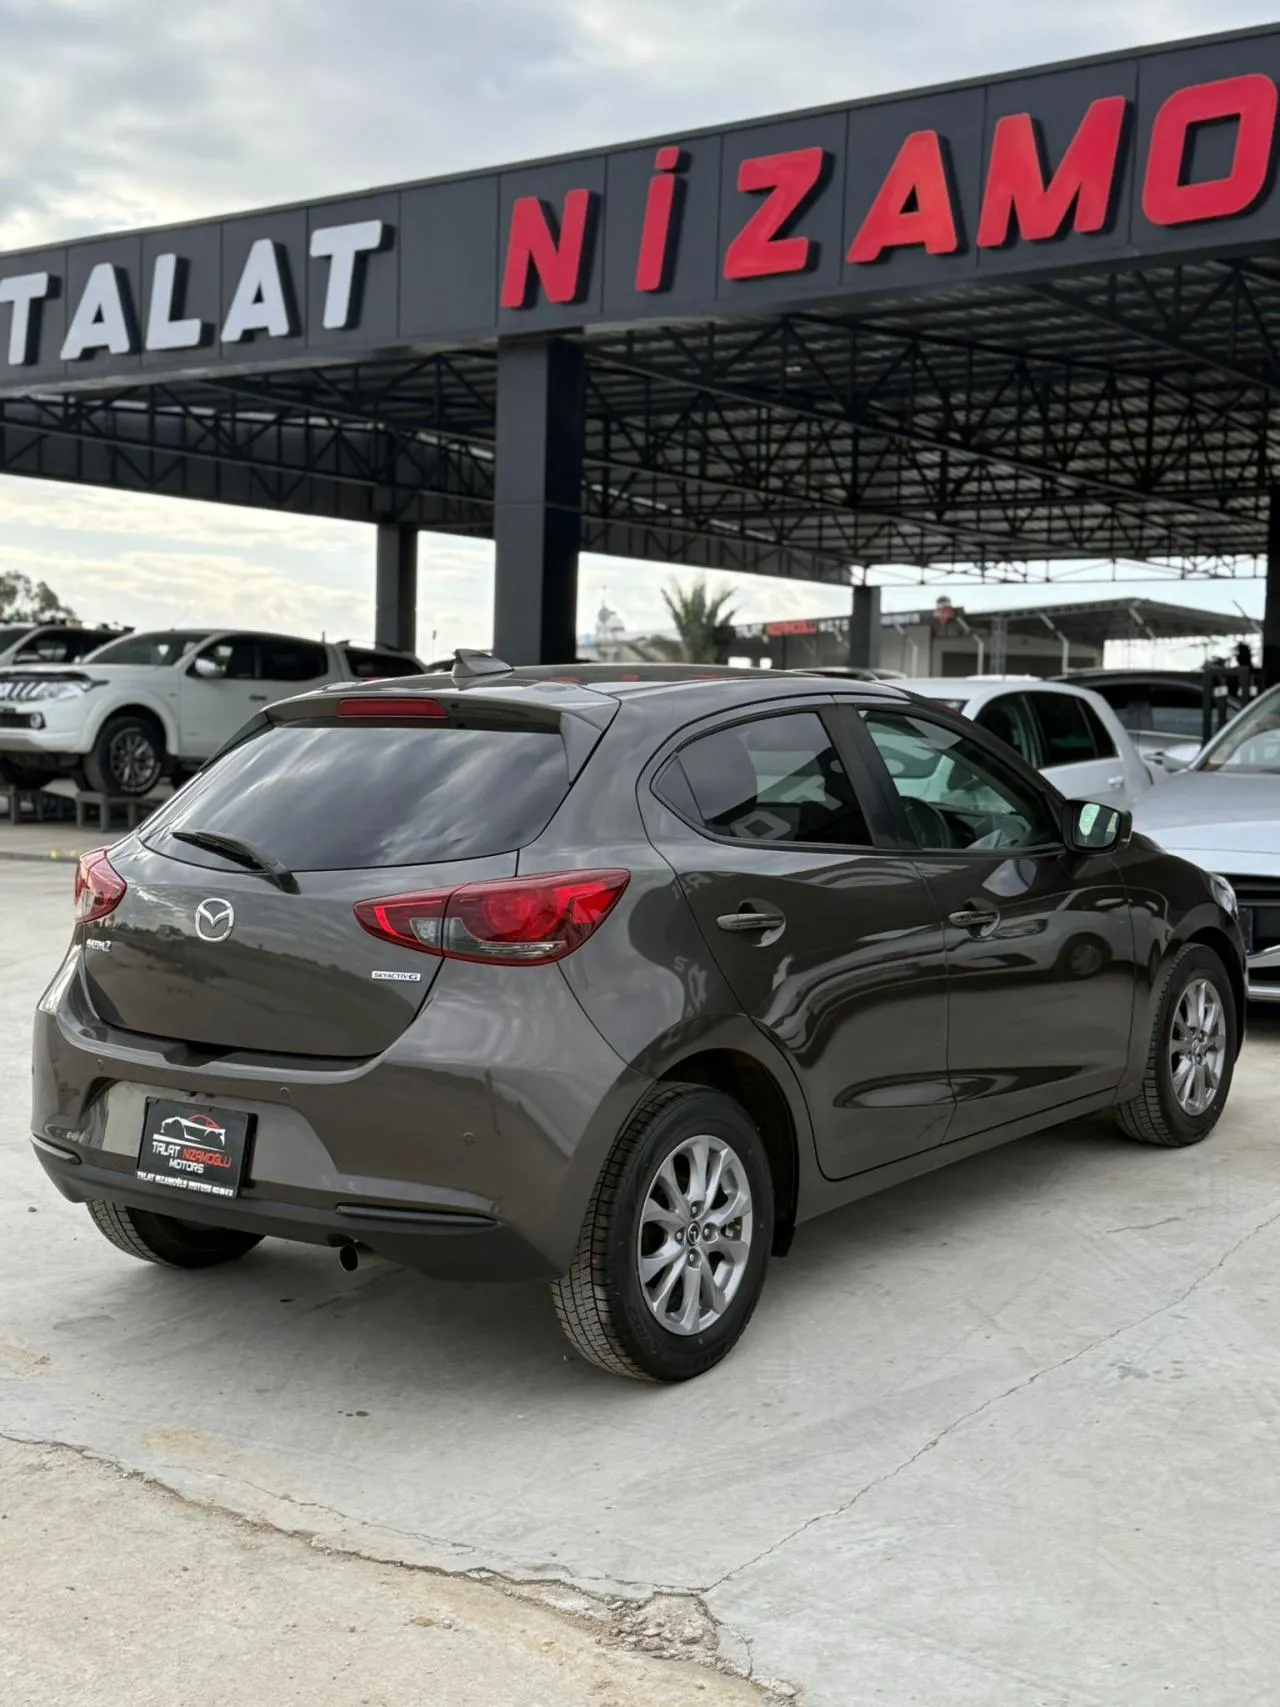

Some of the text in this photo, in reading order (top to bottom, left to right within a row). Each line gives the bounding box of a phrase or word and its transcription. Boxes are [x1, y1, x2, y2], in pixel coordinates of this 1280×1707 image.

[0, 219, 382, 366] TALAT
[152, 1141, 181, 1157] TALAT
[169, 1159, 204, 1173] MOTORS
